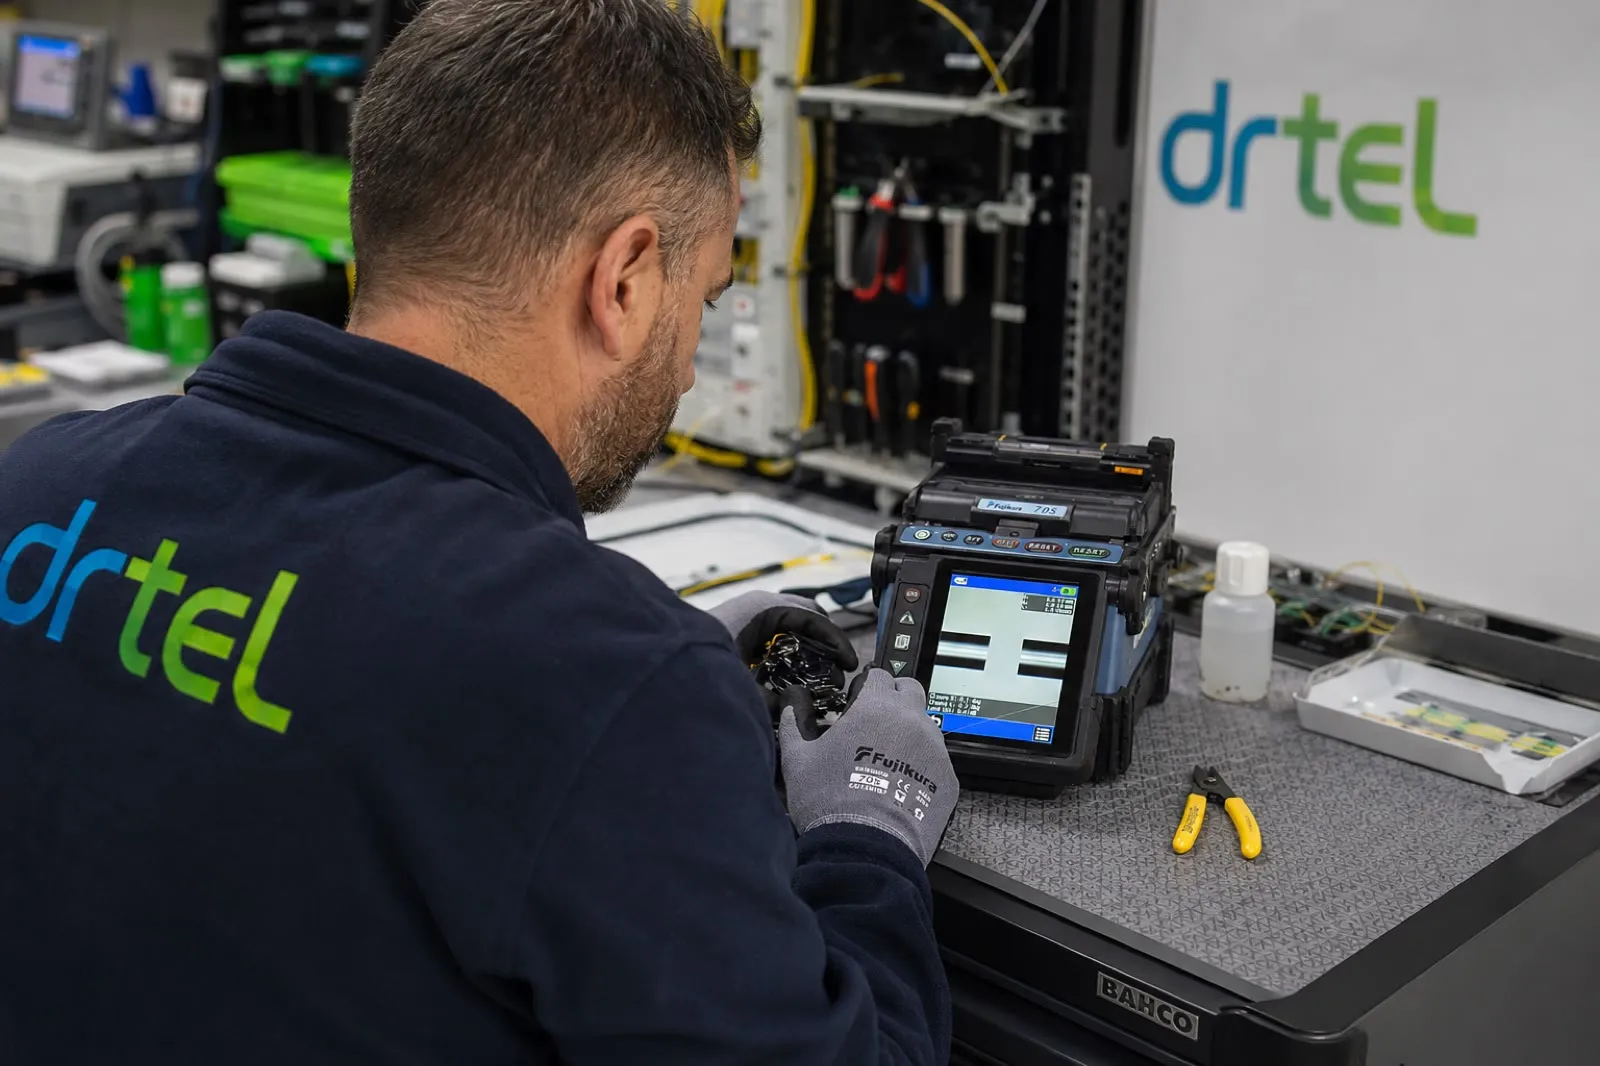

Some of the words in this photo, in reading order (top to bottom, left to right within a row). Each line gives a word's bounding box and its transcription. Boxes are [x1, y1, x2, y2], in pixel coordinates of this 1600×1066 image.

[1159, 79, 1477, 238] drtel
[0, 498, 299, 734] drtel
[871, 752, 938, 794] Fujikura
[1102, 977, 1193, 1034] BAHCO
